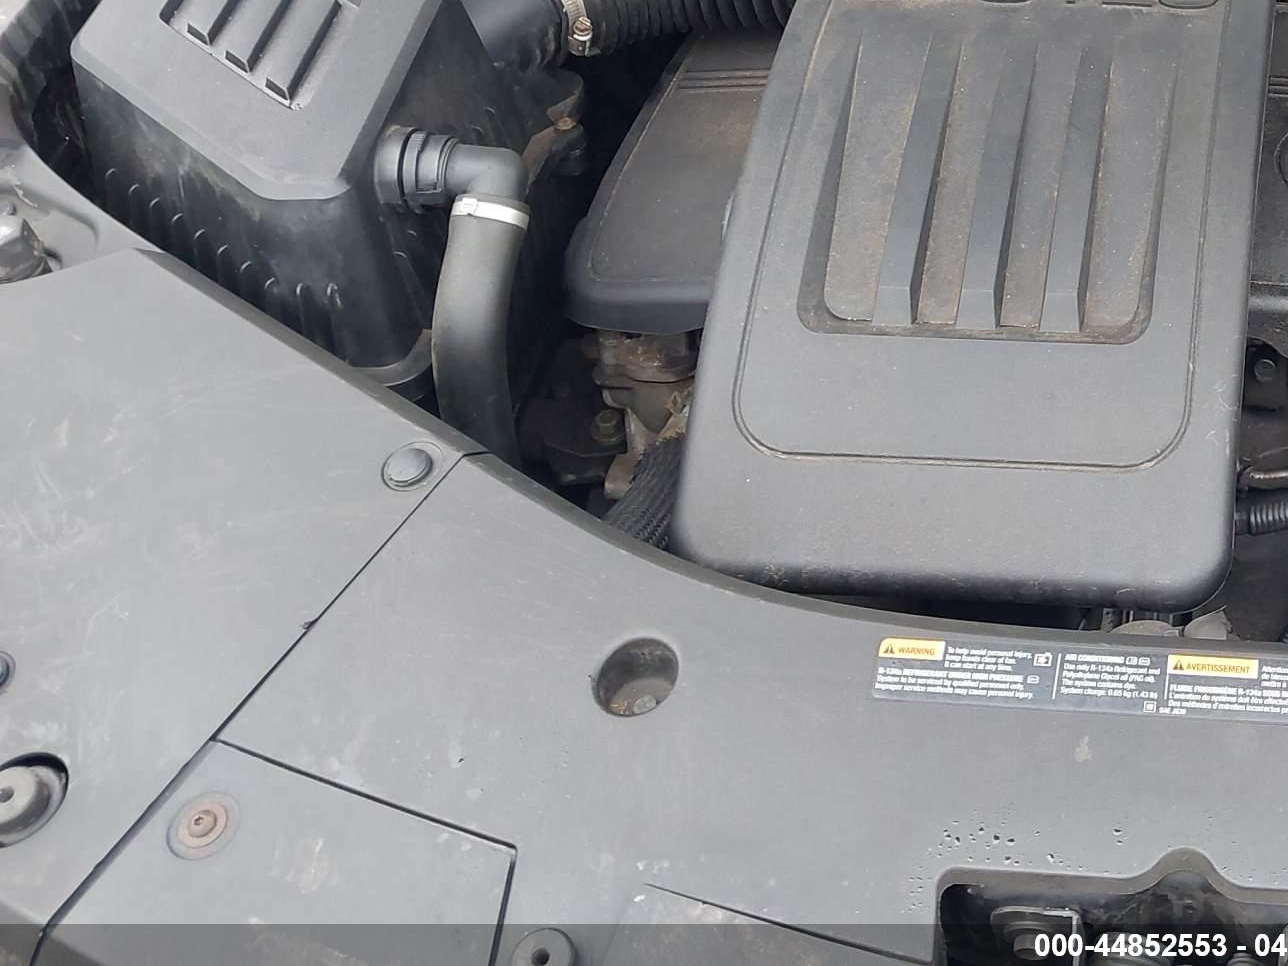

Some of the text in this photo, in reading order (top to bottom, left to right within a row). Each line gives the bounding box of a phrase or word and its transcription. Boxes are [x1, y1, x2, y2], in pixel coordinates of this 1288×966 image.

[898, 647, 935, 656] WARNING
[955, 647, 968, 656] help
[987, 650, 1014, 658] personal
[1186, 663, 1250, 674] AVERTISSEMENT
